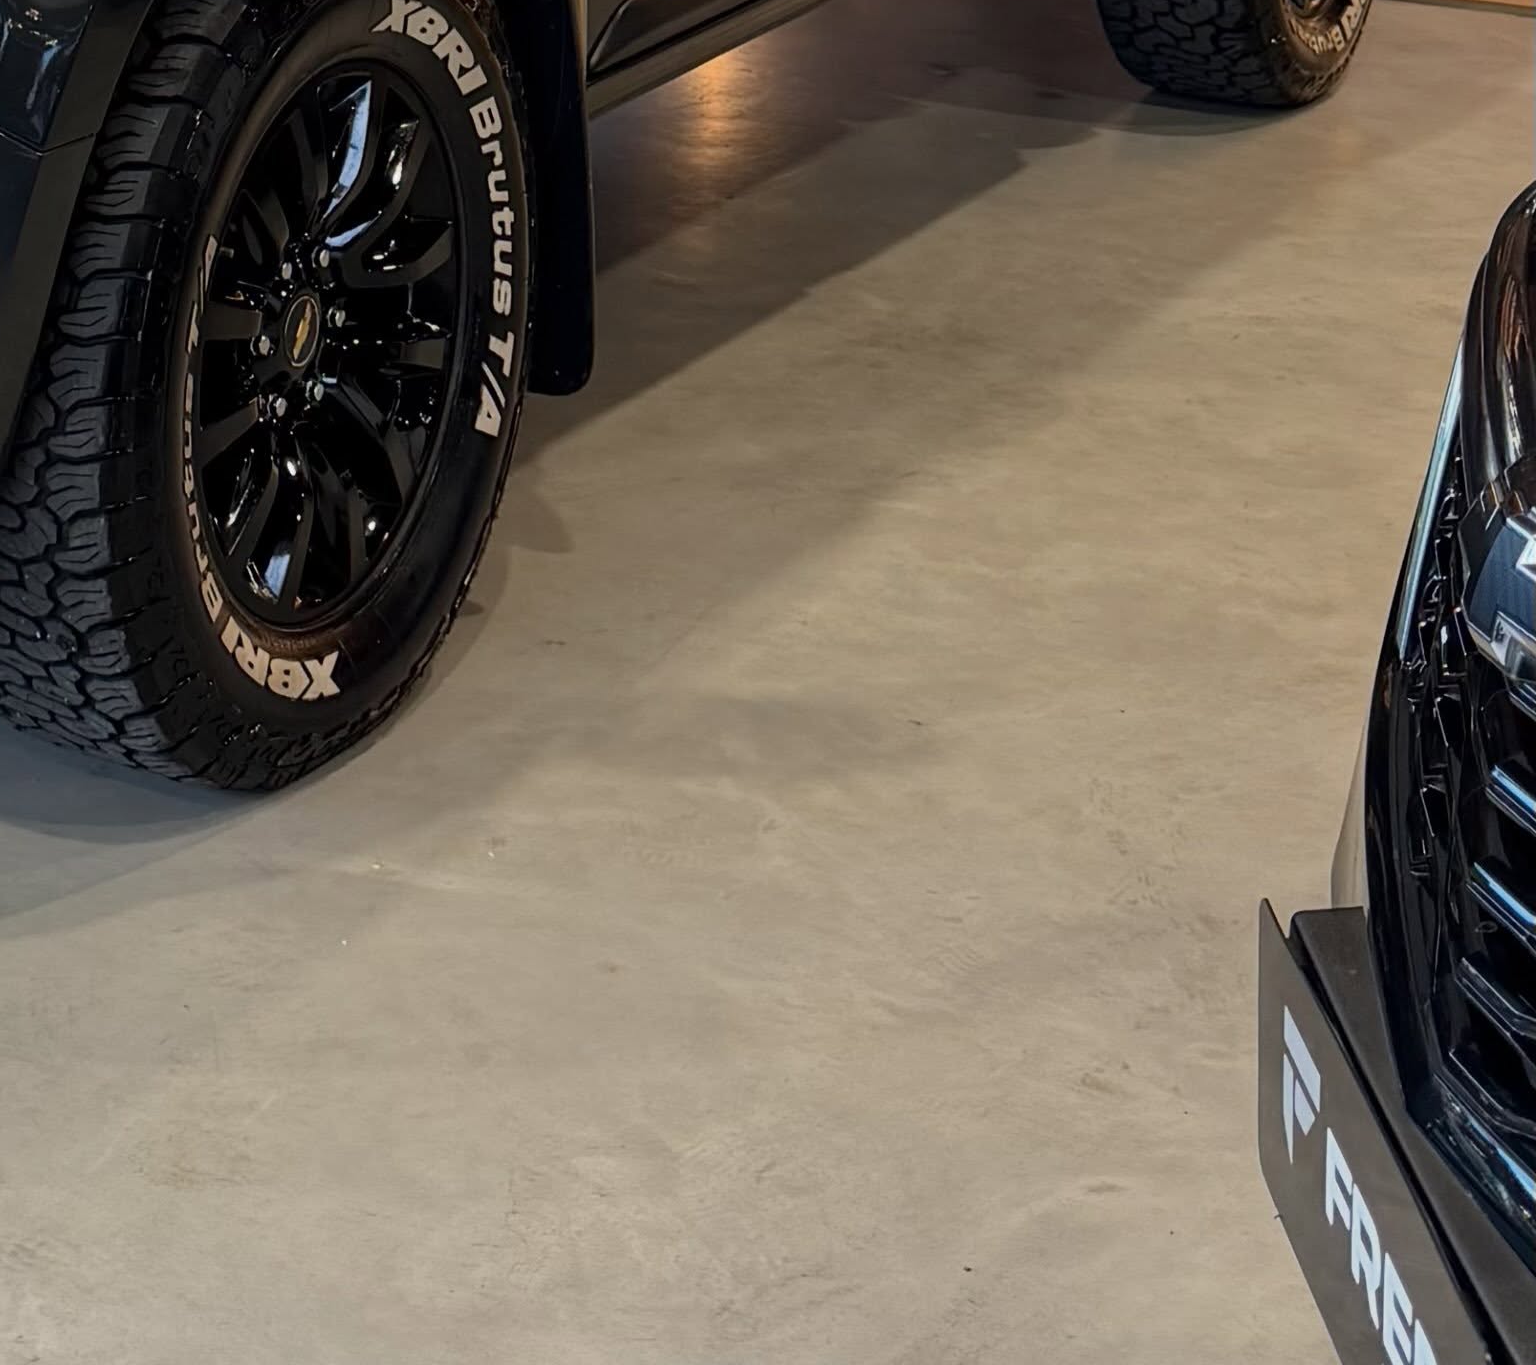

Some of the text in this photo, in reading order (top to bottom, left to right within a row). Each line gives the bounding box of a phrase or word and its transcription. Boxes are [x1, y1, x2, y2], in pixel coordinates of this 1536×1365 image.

[469, 96, 515, 316] Brutus
[474, 331, 515, 437] T/A
[220, 616, 340, 701] XBRI
